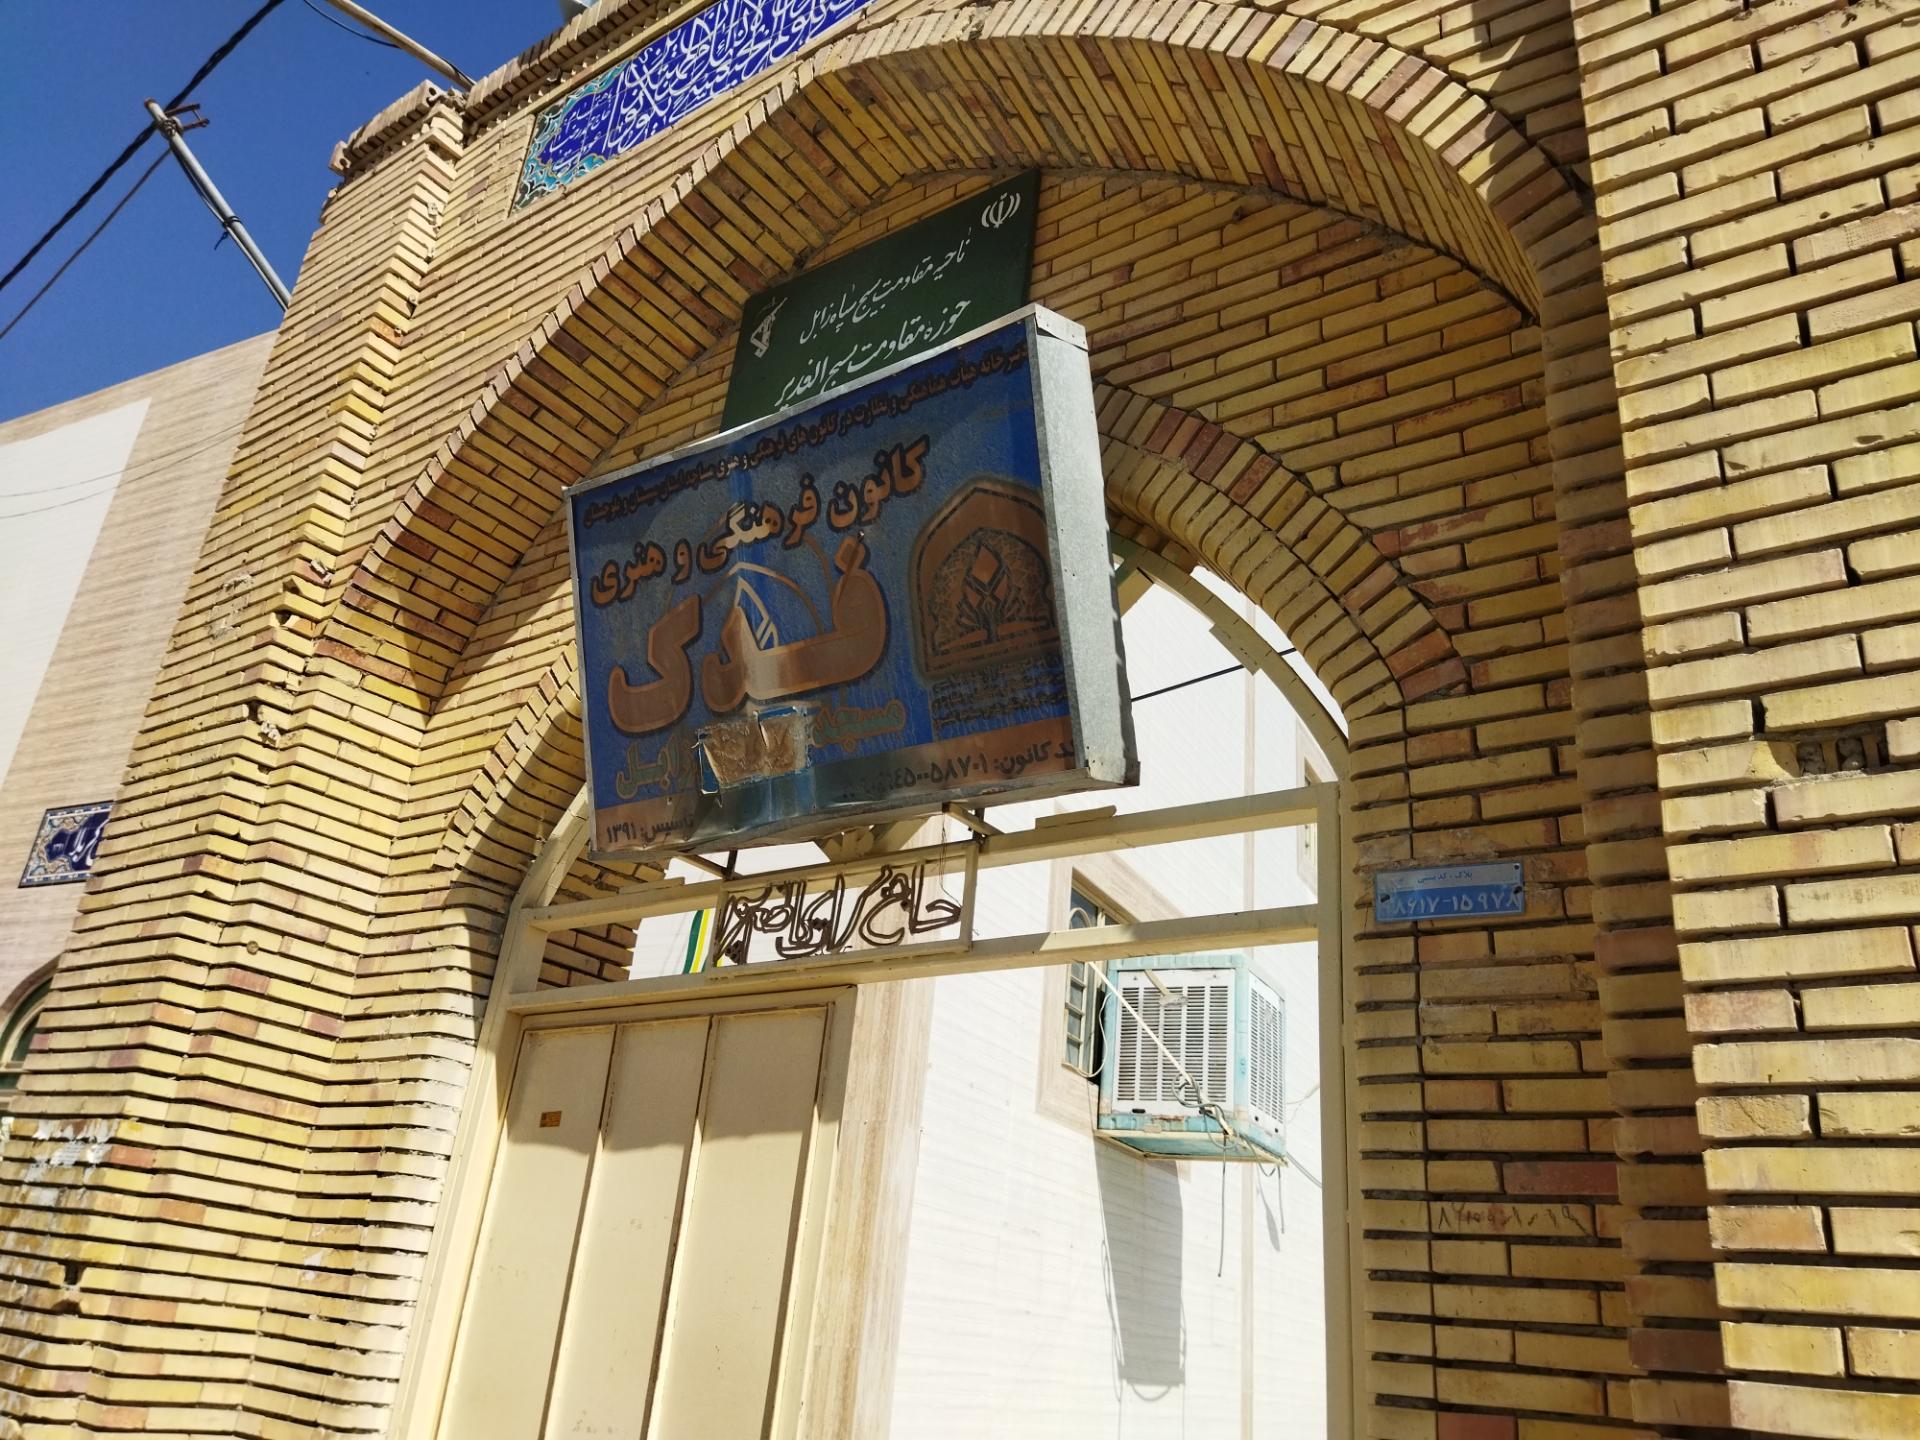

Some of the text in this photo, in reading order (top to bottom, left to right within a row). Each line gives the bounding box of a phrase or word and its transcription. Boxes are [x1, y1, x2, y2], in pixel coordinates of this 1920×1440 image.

[800, 238, 971, 345] ناحیه مقاومت بسیج سپاه زابل
[847, 315, 926, 373] مقاومت
[591, 435, 931, 609] کانون فرهنگی و هنری
[607, 535, 888, 734] فدک
[1381, 890, 1520, 914] ۸۶۱۷-۱۵۹۷۸
